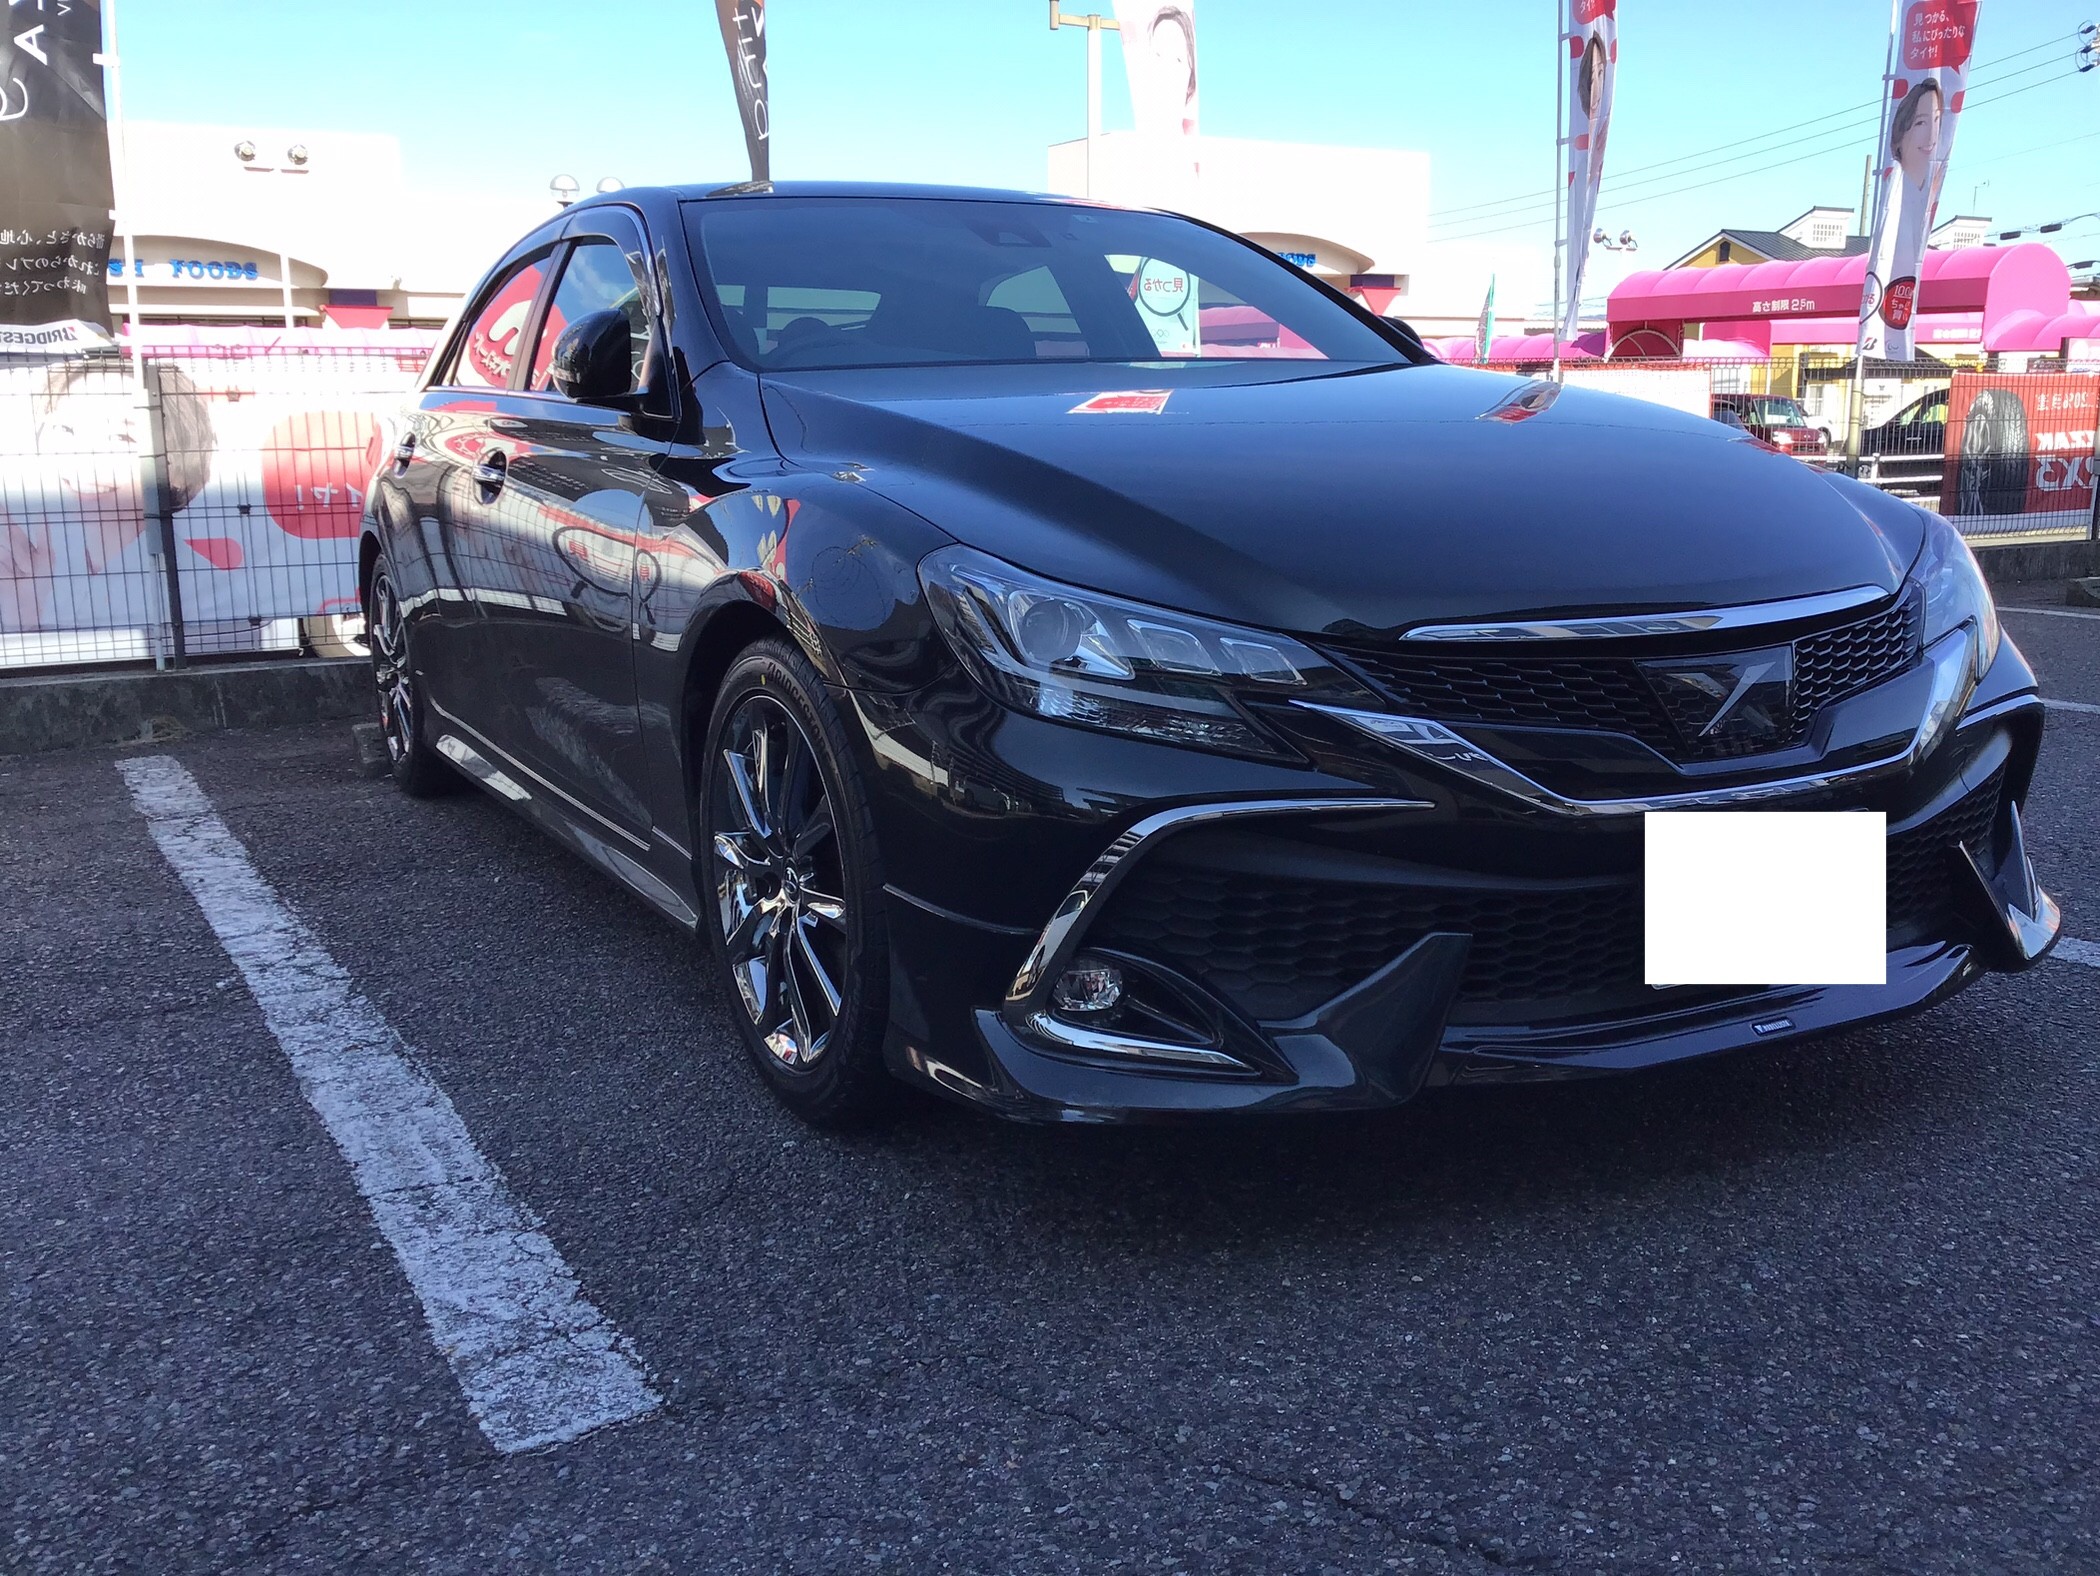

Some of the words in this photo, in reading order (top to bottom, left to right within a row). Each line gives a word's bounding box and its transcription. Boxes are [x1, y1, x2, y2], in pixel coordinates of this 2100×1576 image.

[168, 258, 259, 281] FOODS
[1752, 299, 1789, 313] 高さ制限
